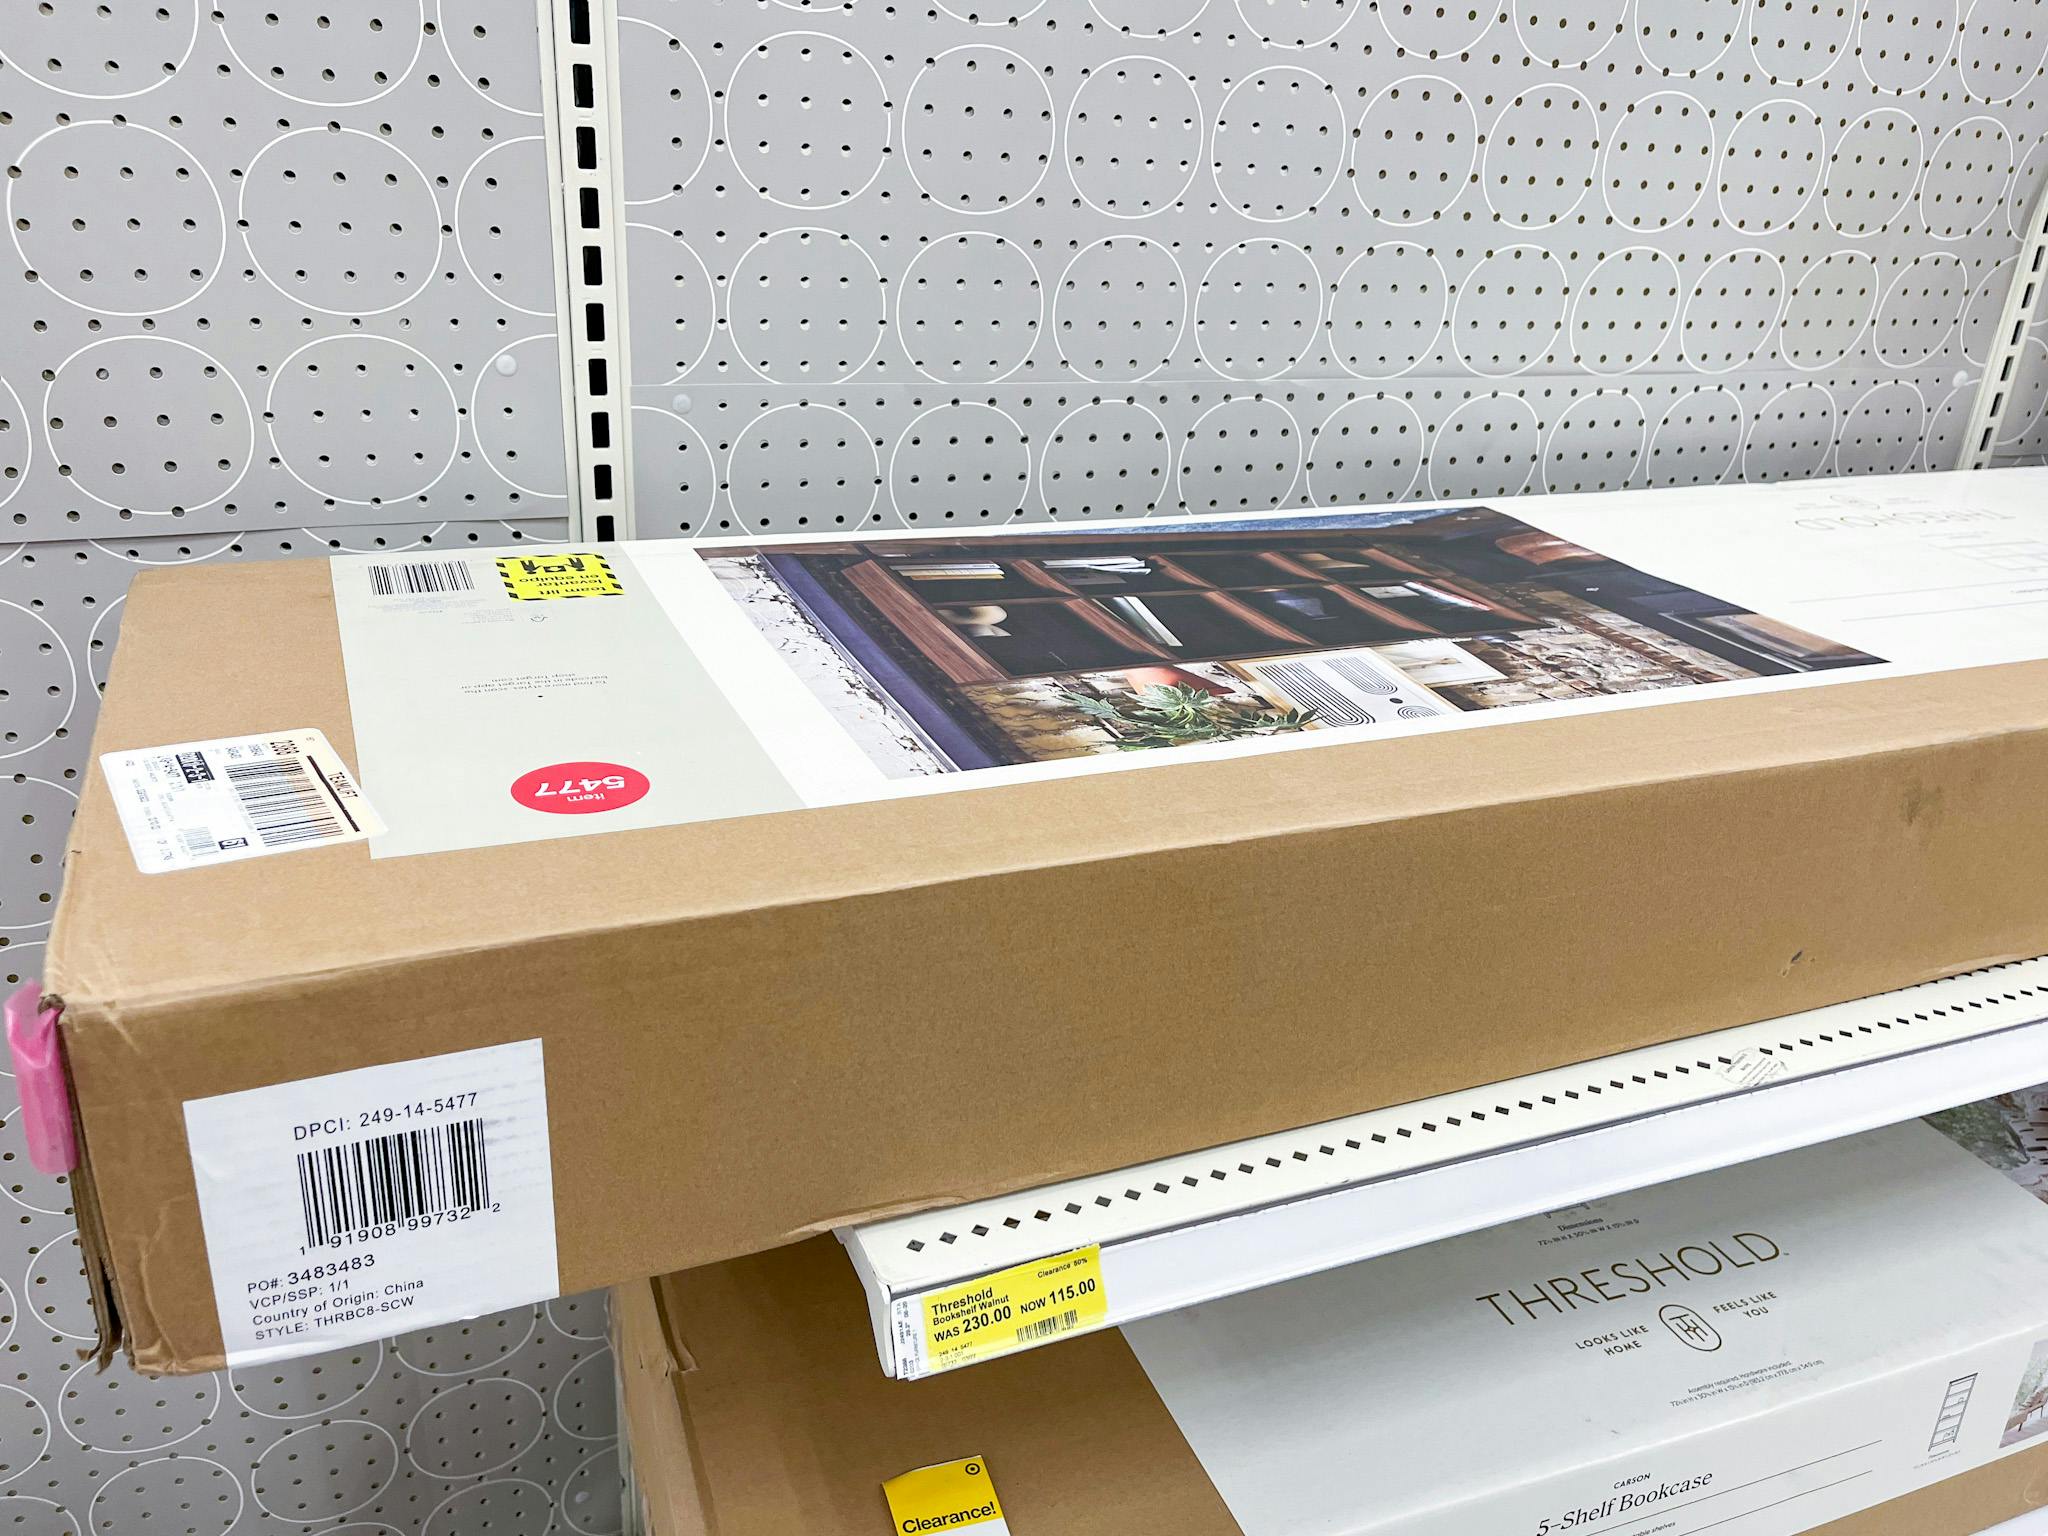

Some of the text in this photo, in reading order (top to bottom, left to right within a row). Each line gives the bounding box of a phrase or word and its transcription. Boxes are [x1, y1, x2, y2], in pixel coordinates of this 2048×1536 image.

[519, 575, 575, 583] equipo
[535, 775, 625, 797] 5477
[566, 792, 606, 802] item
[294, 1092, 478, 1141] DPCI: 249-14-5477
[247, 1254, 376, 1294] PO#: 3483483
[1037, 1263, 1071, 1279] Clearance
[1475, 1232, 1780, 1326] THRESHOLD
[249, 1279, 350, 1311] VCP/SSP: 1/1
[252, 1278, 425, 1327] Country of Origin: China
[931, 1287, 993, 1316] Threshold
[933, 1294, 1009, 1326] Bookshelf Walnut
[1713, 1291, 1777, 1315] FEELS LIKE
[255, 1295, 415, 1341] STYLE: THRBC8-SCW
[934, 1326, 960, 1343] WAS
[962, 1305, 1012, 1333] 230.00
[1020, 1298, 1046, 1314] NOW
[1049, 1278, 1096, 1305] 115.00
[1743, 1306, 1769, 1320] YOU
[1575, 1324, 1649, 1350] LOOKS LIKE
[1603, 1340, 1643, 1357] HOME
[1613, 1472, 1651, 1490] CARSON
[1620, 1470, 1714, 1512] Bookcase
[902, 1501, 997, 1534] Clearance!
